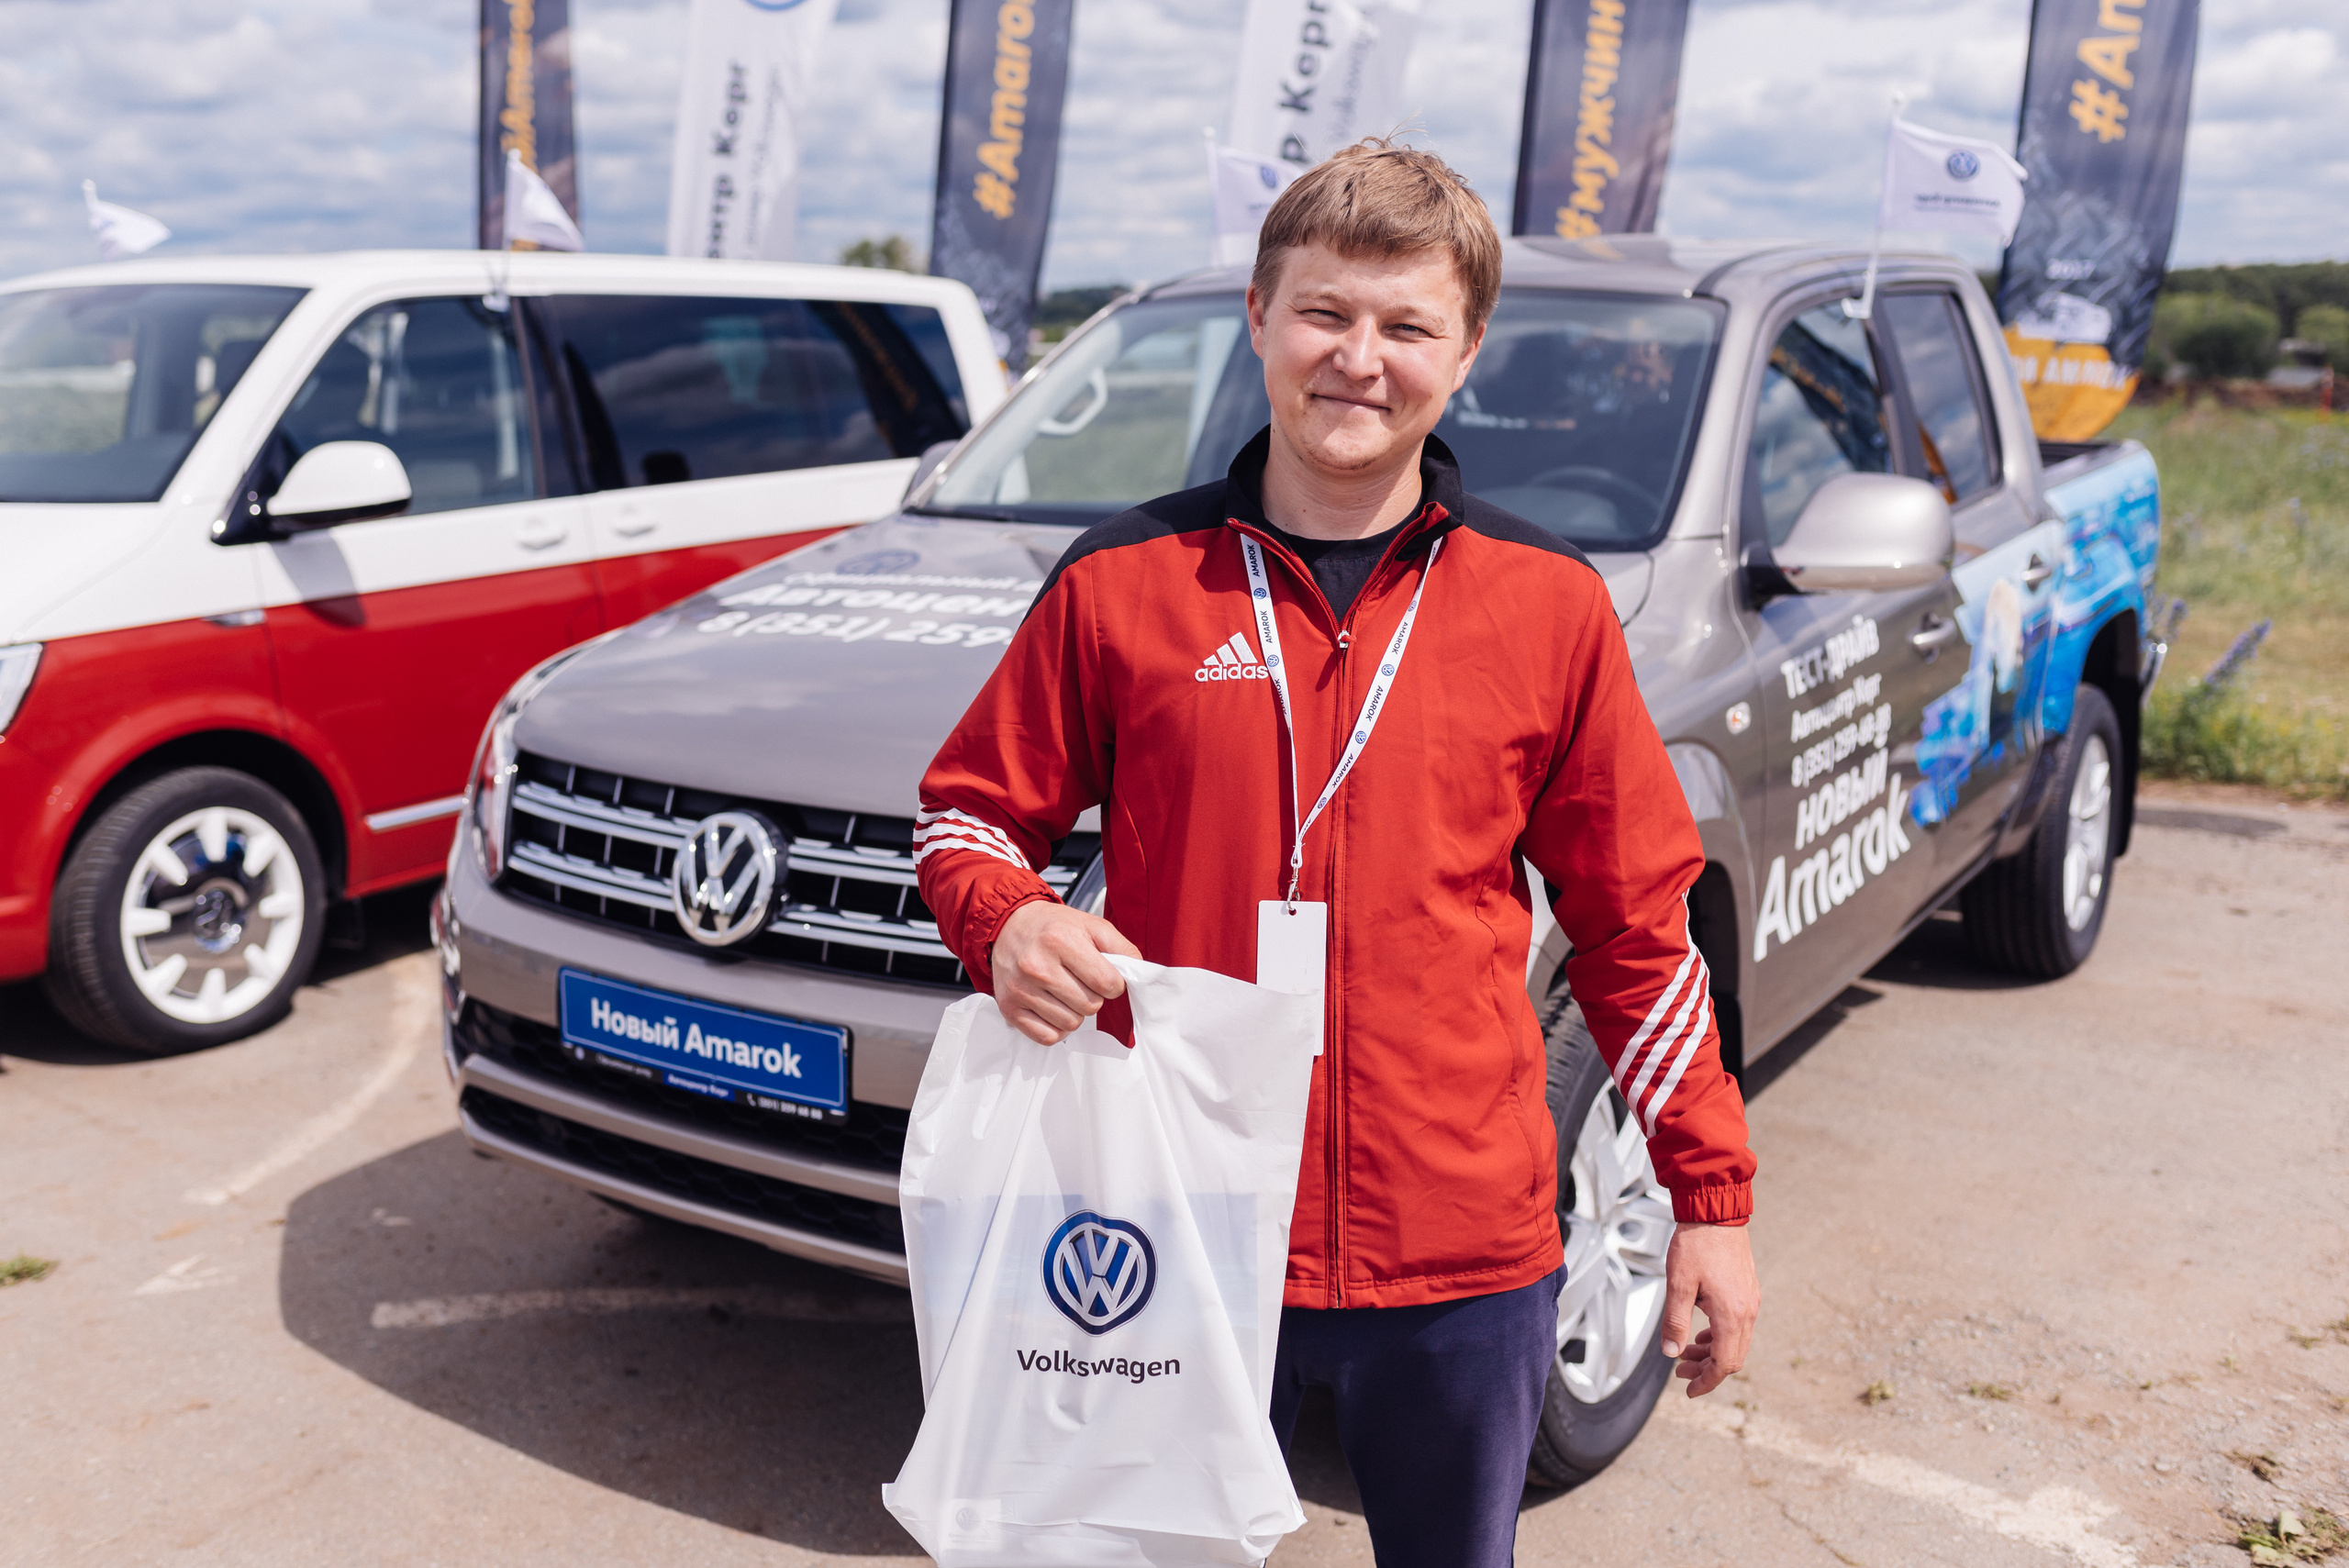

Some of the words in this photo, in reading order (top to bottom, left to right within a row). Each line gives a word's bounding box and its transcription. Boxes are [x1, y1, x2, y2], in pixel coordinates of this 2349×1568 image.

[973, 0, 1036, 220] #Amaro
[1247, 544, 1261, 577] AMAROK
[1261, 610, 1274, 644] AMAROK
[1391, 621, 1408, 655] AMAROK
[1194, 662, 1269, 683] adidas
[1365, 684, 1384, 722] AMAROK
[1331, 752, 1354, 788] AMAROK
[1753, 772, 1911, 963] Amarok
[590, 996, 680, 1051] Новый
[683, 1022, 803, 1079] Amarok
[1016, 1349, 1181, 1385] Volkswagen
